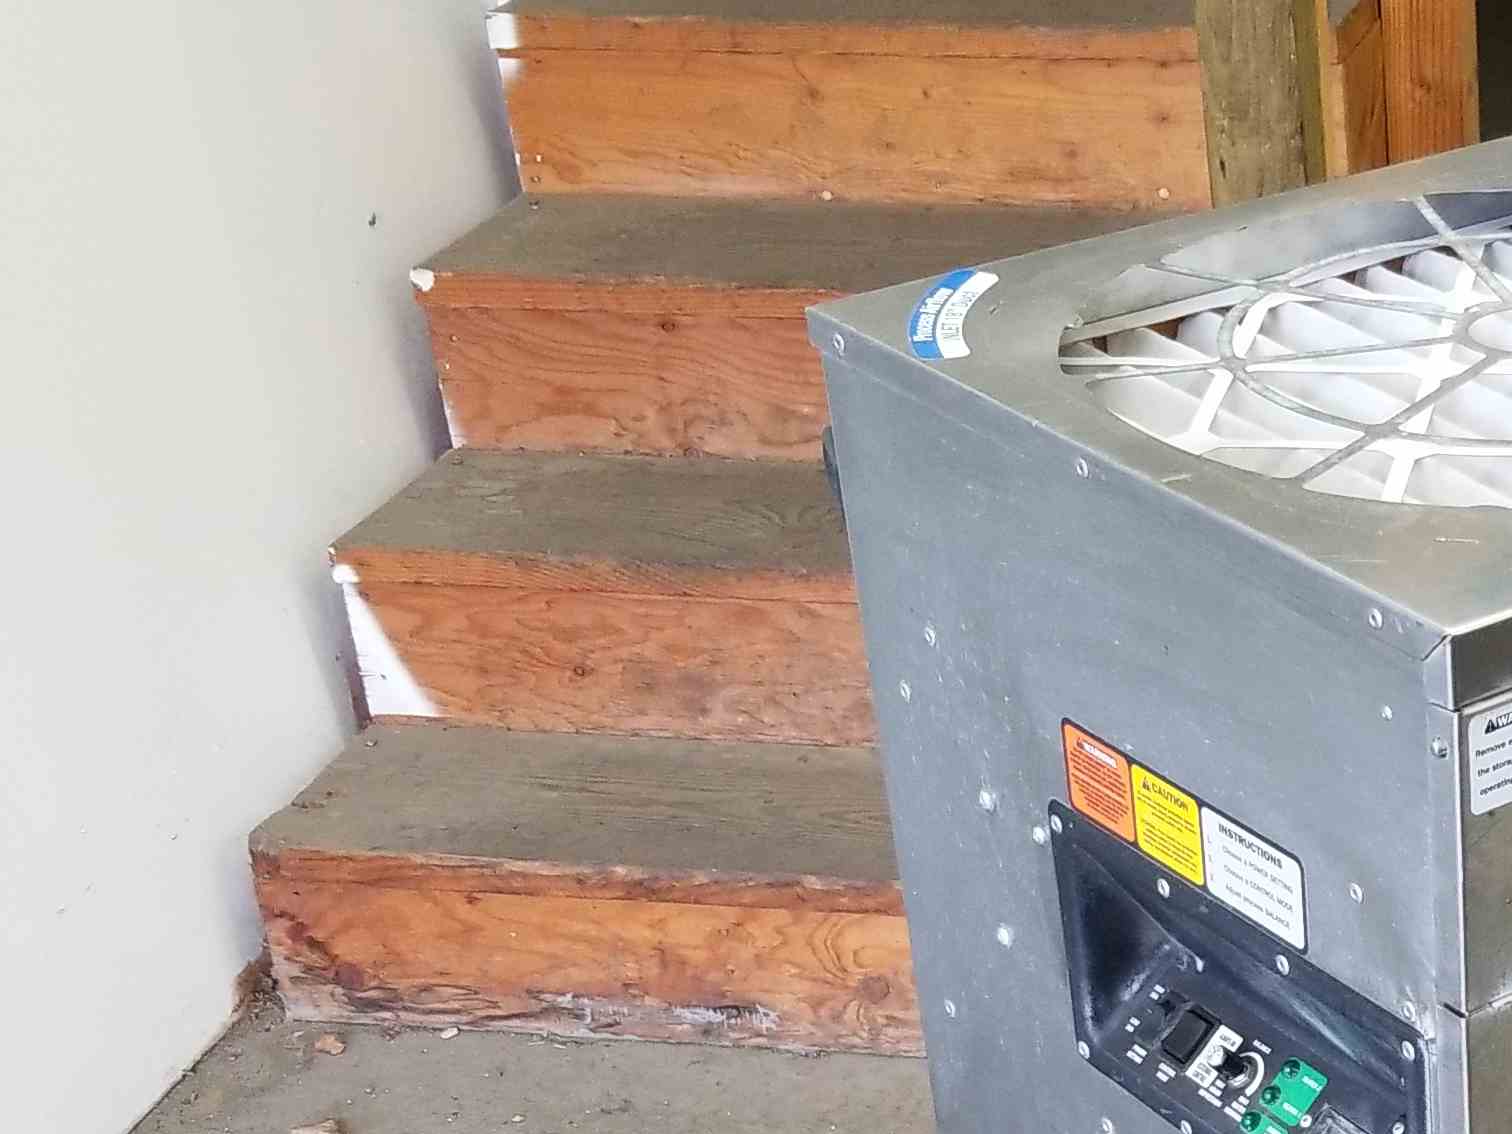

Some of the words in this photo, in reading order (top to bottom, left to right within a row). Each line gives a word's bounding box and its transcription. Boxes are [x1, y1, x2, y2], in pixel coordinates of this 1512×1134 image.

[1475, 739, 1506, 760] Remove
[1477, 764, 1490, 777] the
[1151, 782, 1189, 815] CAUTION
[1218, 822, 1282, 870] INSTRUCTIONS
